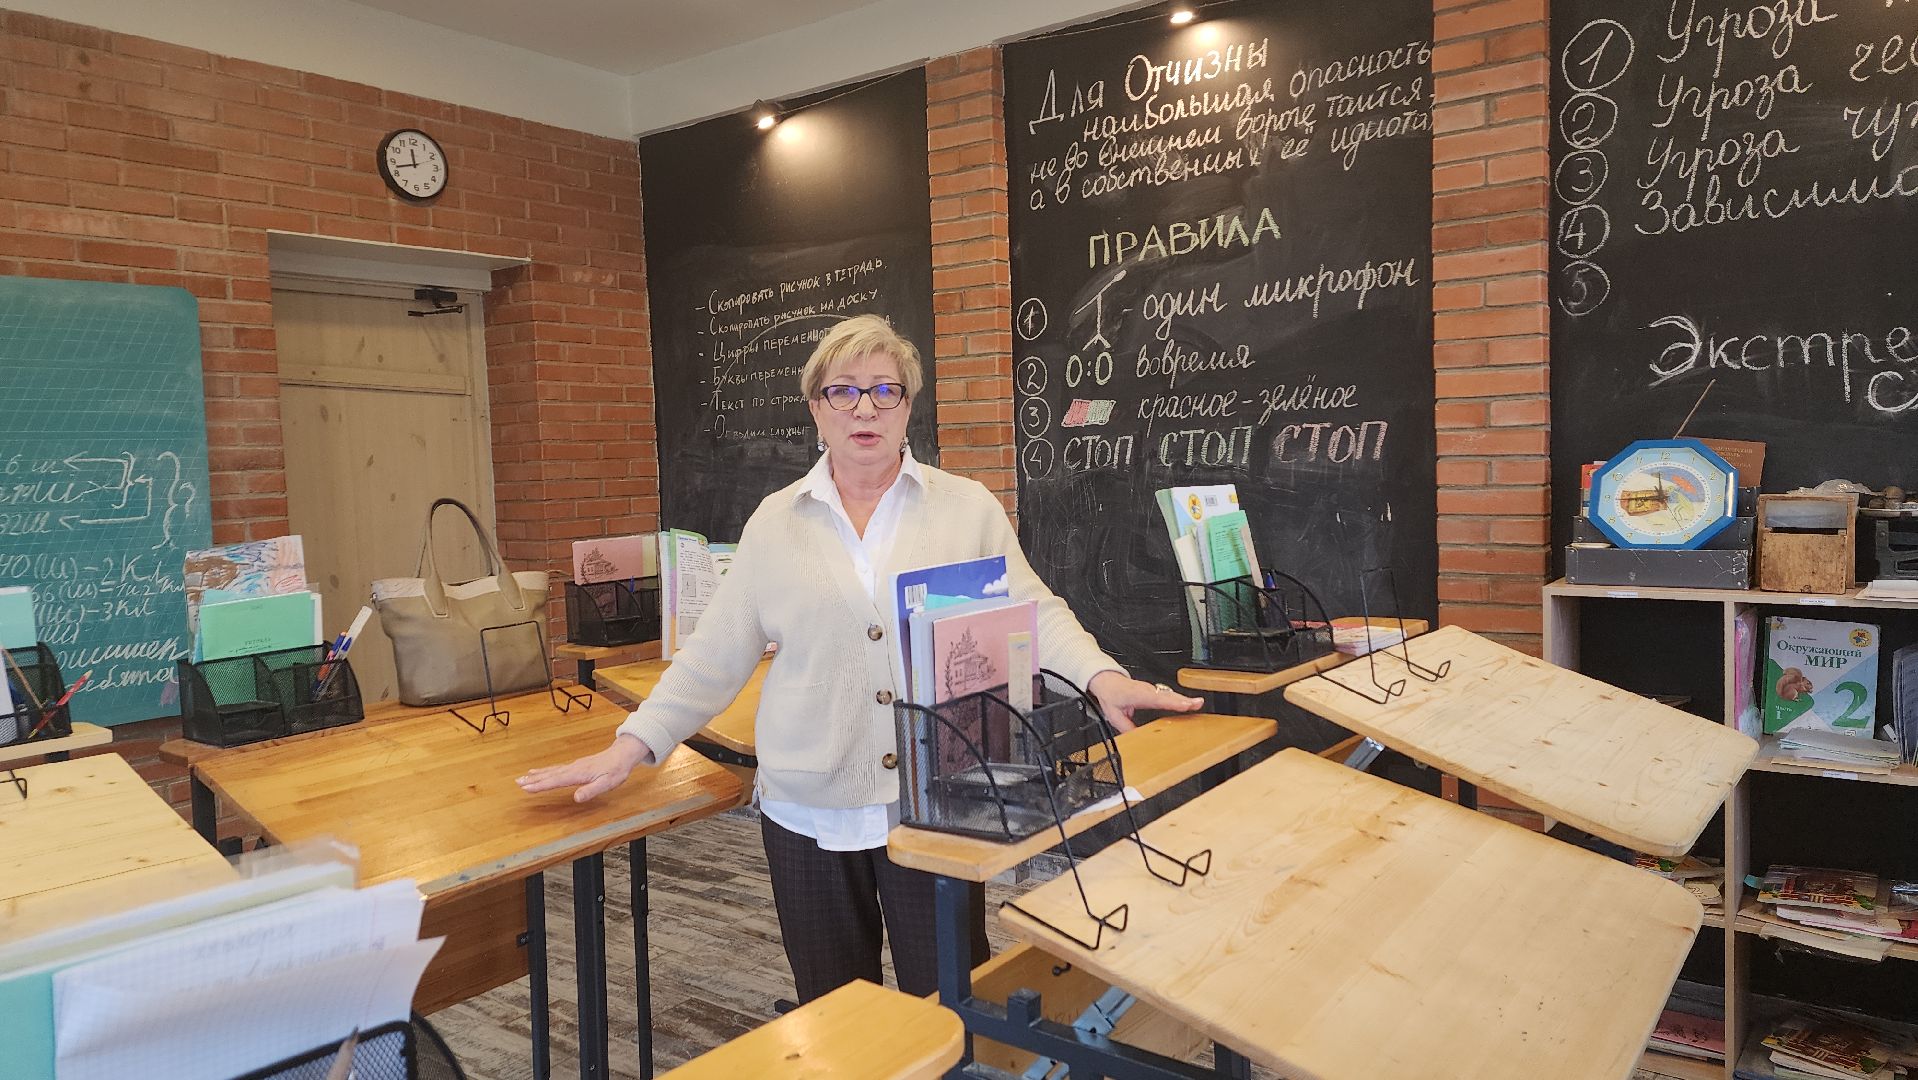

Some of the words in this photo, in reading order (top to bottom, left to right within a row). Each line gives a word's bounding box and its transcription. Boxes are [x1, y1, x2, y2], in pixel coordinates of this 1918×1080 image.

[1656, 0, 1839, 79] Угроза
[1029, 69, 1104, 135] Для
[1125, 38, 1269, 101] Отчизны
[1290, 40, 1431, 99] опасность
[1652, 64, 1813, 142] Угроза
[409, 138, 418, 146] 12
[429, 152, 435, 160] 2
[432, 164, 439, 172] 3
[1030, 189, 1045, 210] а
[1055, 169, 1071, 204] в
[1331, 110, 1432, 170] идиота
[1031, 158, 1056, 183] не
[1099, 126, 1223, 166] внешнем
[1637, 129, 1800, 202] Угроза
[1088, 207, 1281, 268] ПРАВИЛА
[1144, 283, 1228, 340] один
[1243, 258, 1420, 319] микрофон
[1066, 352, 1113, 388] 0:0
[1136, 338, 1255, 389] вовремя
[1064, 434, 1133, 471] СТОП
[1160, 426, 1253, 468] СТОП
[1272, 421, 1388, 463] СТОП
[1777, 639, 1862, 658] Окружающий
[1804, 655, 1848, 669] МИР
[1831, 681, 1871, 729] 2
